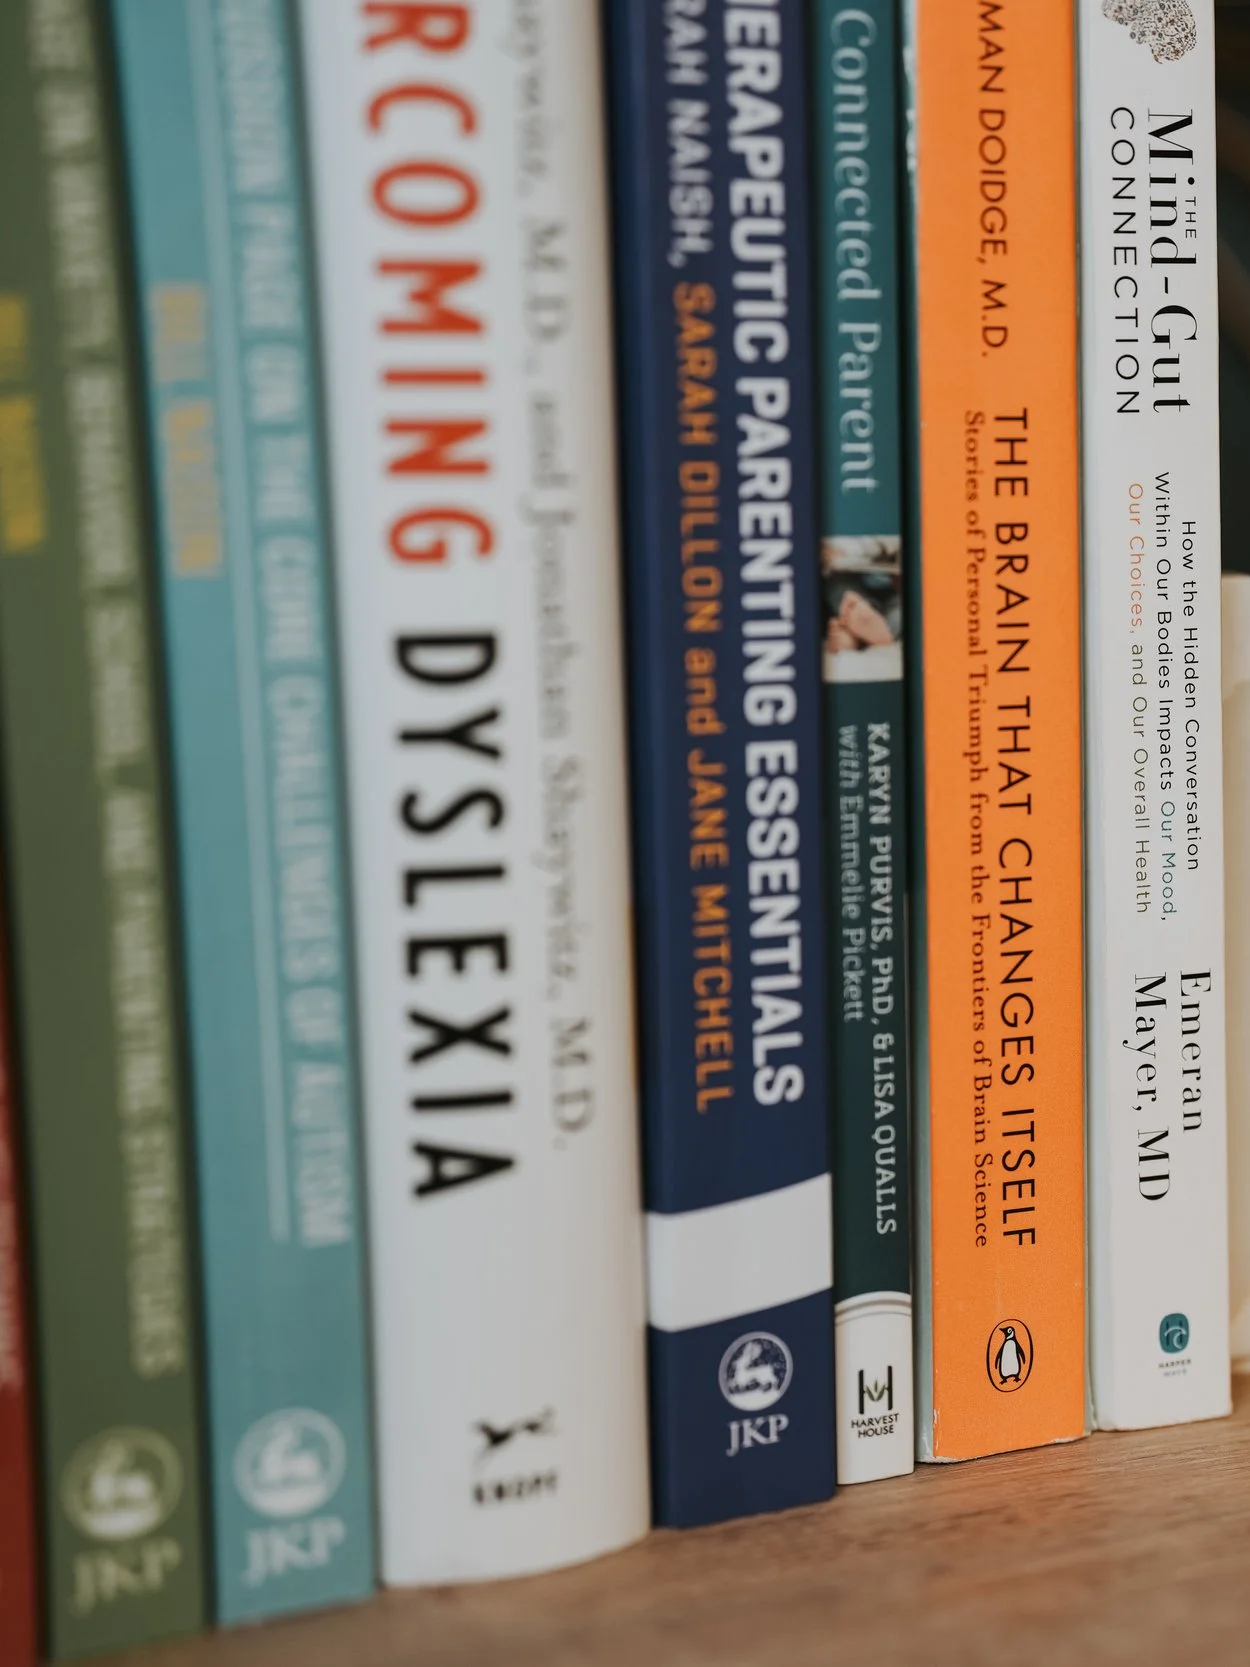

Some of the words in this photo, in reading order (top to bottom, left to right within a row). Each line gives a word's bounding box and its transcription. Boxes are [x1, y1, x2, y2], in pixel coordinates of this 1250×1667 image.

[978, 0, 1005, 93] MAN
[667, 98, 714, 268] NAISH,
[724, 0, 789, 362] ERAPEUTIC
[829, 9, 882, 301] Connected
[976, 109, 1007, 264] DOIDGE,
[1110, 107, 1140, 413] CONNECTION
[1148, 108, 1197, 413] Mind-Gut
[1185, 196, 1197, 239] THE
[362, 0, 494, 564] RCOMING
[980, 280, 1008, 357] M.D.
[672, 282, 718, 446] SARAH
[838, 322, 882, 493] Parent
[964, 410, 986, 501] Stories
[994, 407, 1028, 497] THE
[678, 460, 723, 633] DILLON
[966, 510, 986, 540] of
[1128, 483, 1143, 524] Our
[1155, 471, 1171, 548] Within
[1181, 521, 1196, 569] How
[735, 376, 798, 727] PARENTING
[995, 523, 1030, 673] BRAIN
[1129, 535, 1146, 634] Choices,
[1156, 558, 1171, 600] Our
[1183, 580, 1198, 617] the
[966, 547, 988, 656] Personal
[684, 647, 727, 736] and
[1131, 644, 1147, 685] and
[1157, 611, 1173, 689] Bodies
[1183, 628, 1199, 708] Hidden
[838, 724, 864, 789] with
[963, 664, 989, 782] Triumph
[997, 695, 1031, 815] THAT
[1132, 696, 1147, 737] Our
[1156, 699, 1174, 790] Impacts
[686, 748, 730, 870] JANE
[867, 722, 891, 825] KARYN
[1133, 748, 1150, 829] Overall
[1185, 719, 1201, 871] Conversation
[839, 795, 865, 920] Emmelie
[970, 793, 989, 855] from
[1161, 801, 1175, 842] Our
[394, 633, 514, 1197] DYSLEXIA
[745, 739, 804, 1106] ESSENTIALS
[869, 835, 893, 951] PURVIS,
[971, 865, 990, 904] the
[1135, 840, 1151, 913] Health
[1160, 852, 1177, 921] Mood,
[692, 883, 734, 1115] MITCHELL
[842, 927, 867, 1023] Pickett
[870, 956, 894, 1025] PhD,
[971, 914, 991, 1032] Frontiers
[998, 838, 1035, 1085] CHANGES
[549, 1015, 594, 1150] M.D.
[872, 1032, 895, 1051] &
[873, 1055, 896, 1120] LISA
[972, 1040, 992, 1068] of
[1122, 972, 1167, 1111] Mayer,
[1180, 968, 1211, 1133] Emeran
[974, 1072, 993, 1145] Brain
[871, 1124, 897, 1234] QUALLS
[974, 1152, 994, 1248] Science
[1001, 1108, 1036, 1246] ITSELF
[1137, 1126, 1170, 1201] MD
[726, 1413, 789, 1457] JKP
[851, 1413, 899, 1428] HARVEST
[858, 1424, 895, 1438] HOUSE
